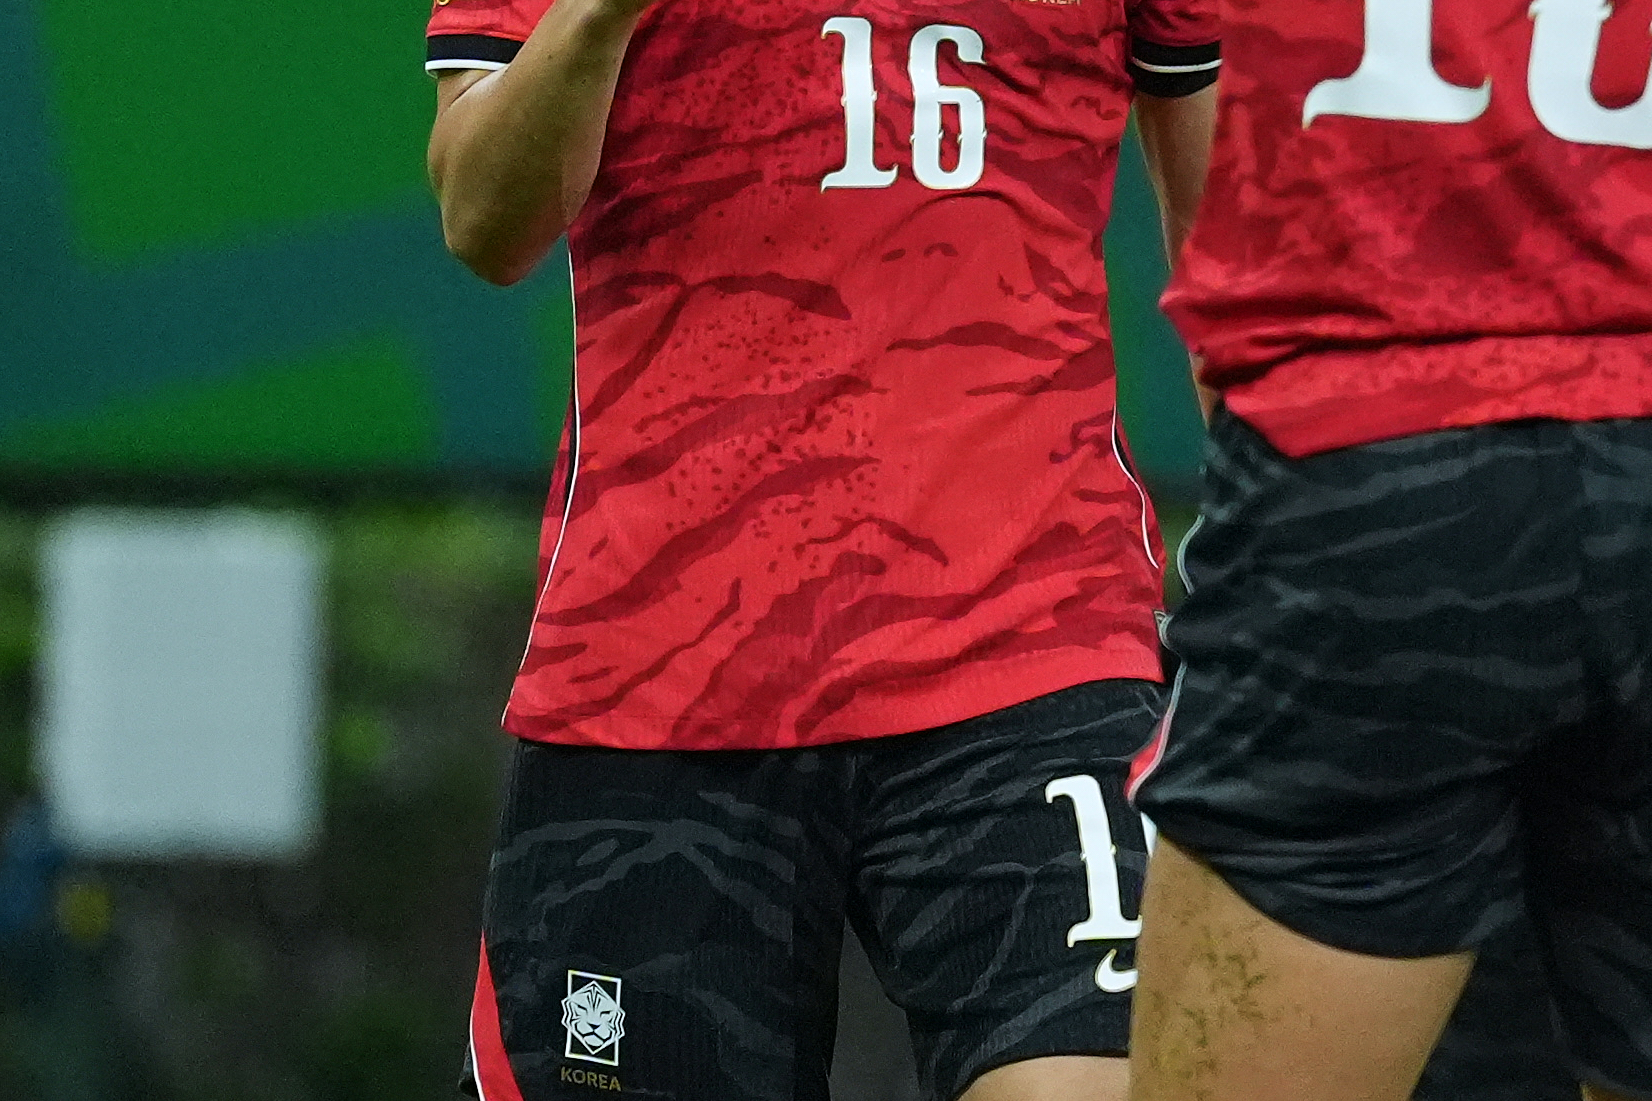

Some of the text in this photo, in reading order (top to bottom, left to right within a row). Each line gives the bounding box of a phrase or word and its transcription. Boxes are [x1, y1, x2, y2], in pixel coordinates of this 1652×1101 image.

[820, 15, 988, 194] 16
[1045, 774, 1158, 948] 1
[560, 1065, 622, 1092] KOREA
